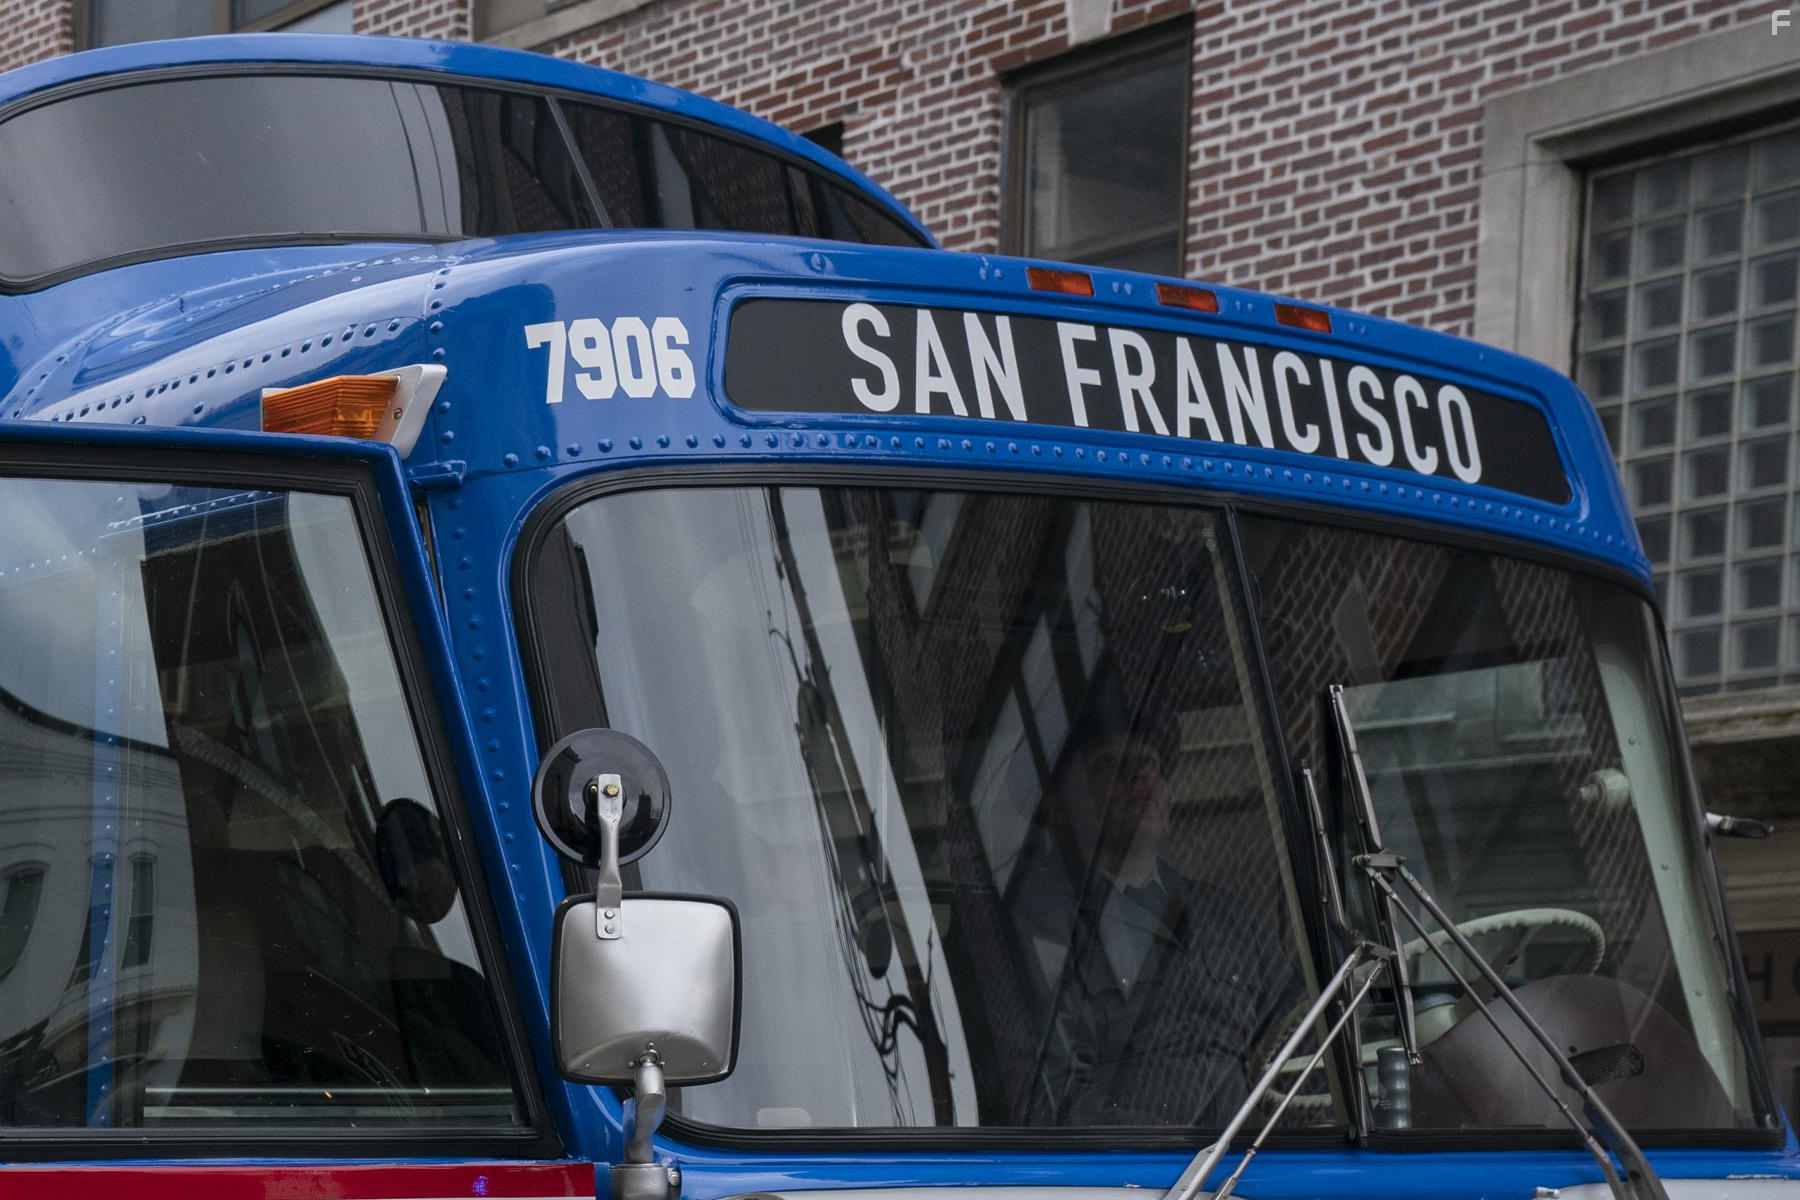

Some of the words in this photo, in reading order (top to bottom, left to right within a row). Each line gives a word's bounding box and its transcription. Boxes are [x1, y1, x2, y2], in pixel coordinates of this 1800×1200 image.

[525, 316, 696, 404] 7906
[842, 302, 1028, 423] SAN
[1056, 321, 1481, 484] FRANCISCO
